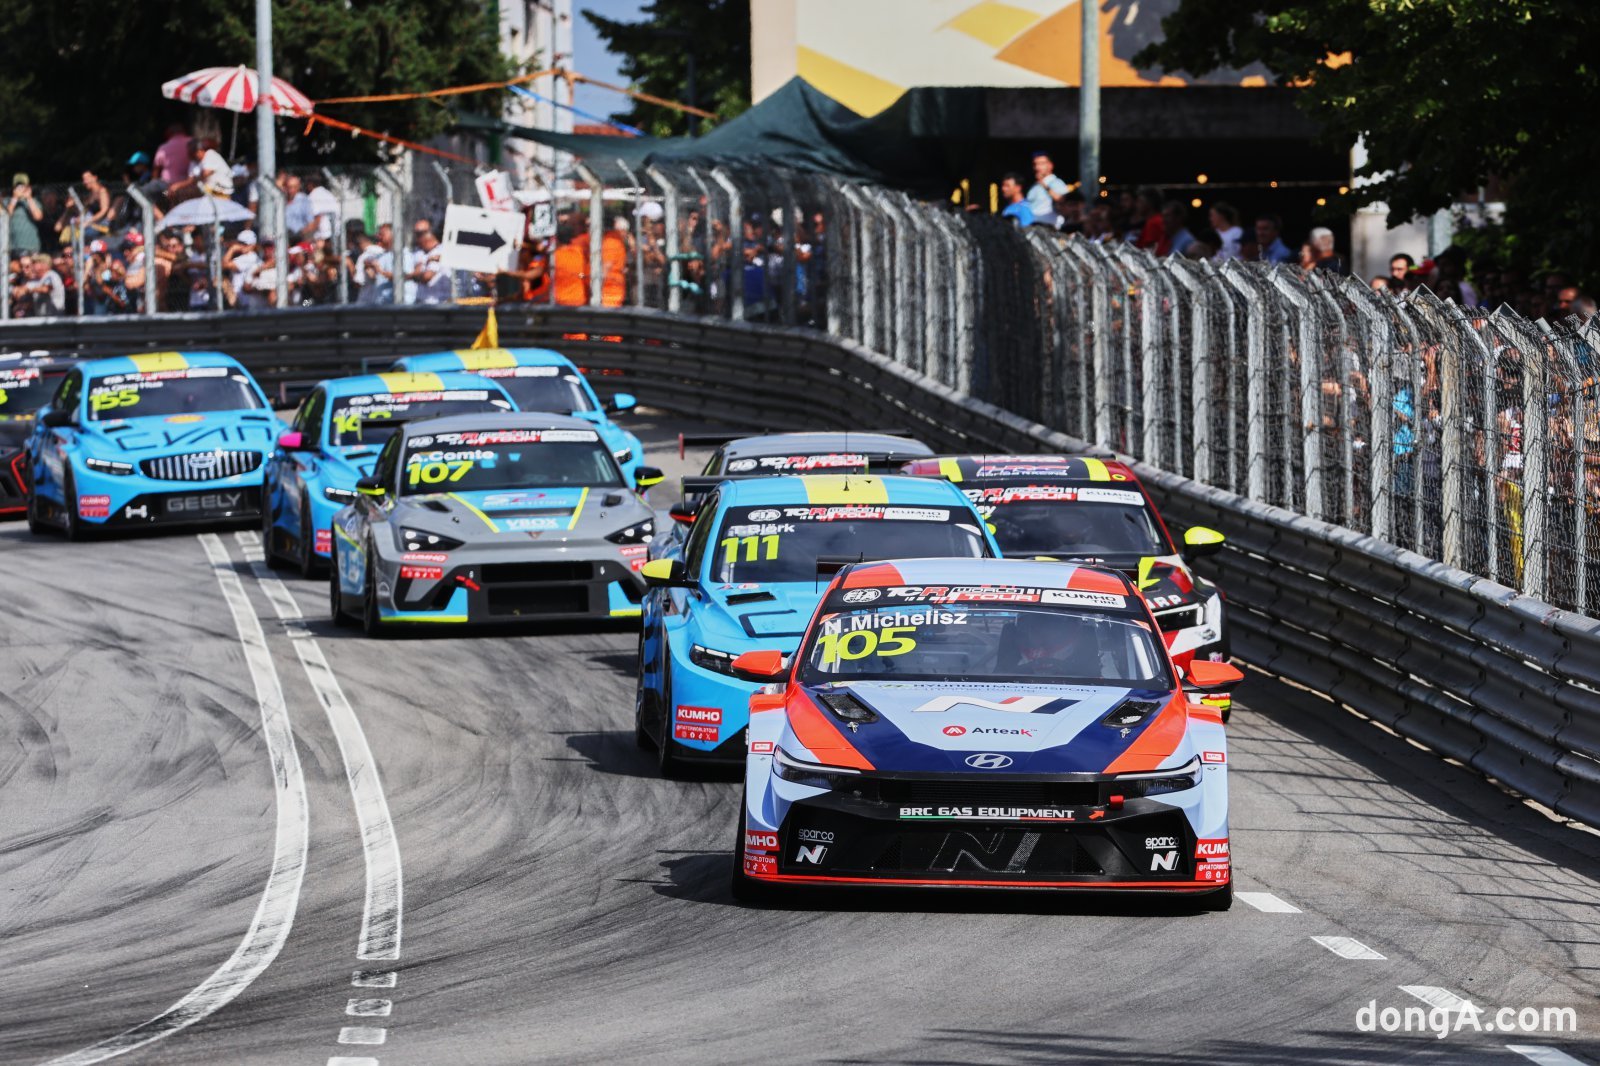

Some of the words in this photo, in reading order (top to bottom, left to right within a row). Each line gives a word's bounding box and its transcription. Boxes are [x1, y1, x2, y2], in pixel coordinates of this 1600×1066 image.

[89, 389, 141, 412] 155
[407, 460, 474, 485] 107
[167, 493, 242, 512] GEELY
[748, 509, 781, 521] FIA
[783, 507, 828, 518] TCR
[836, 512, 882, 520] TOUR
[891, 509, 942, 517] KUMHO
[721, 534, 780, 564] 111
[844, 588, 880, 603] FIA
[886, 586, 950, 598] TCR
[953, 586, 1023, 594] WORLD
[967, 593, 1034, 601] TOUR
[1052, 592, 1117, 602] KUMHO
[825, 610, 968, 635] N.Michelisz
[818, 626, 918, 664] 105
[677, 709, 721, 722] KUMHO
[971, 726, 1034, 738] Arteak
[899, 807, 933, 817] BRC
[938, 806, 973, 817] GAS
[978, 807, 1075, 819] EQUIPMENT
[745, 835, 778, 847] MHO
[798, 828, 835, 842] sparco
[1145, 836, 1179, 850] sparco
[1197, 843, 1229, 855] KUM
